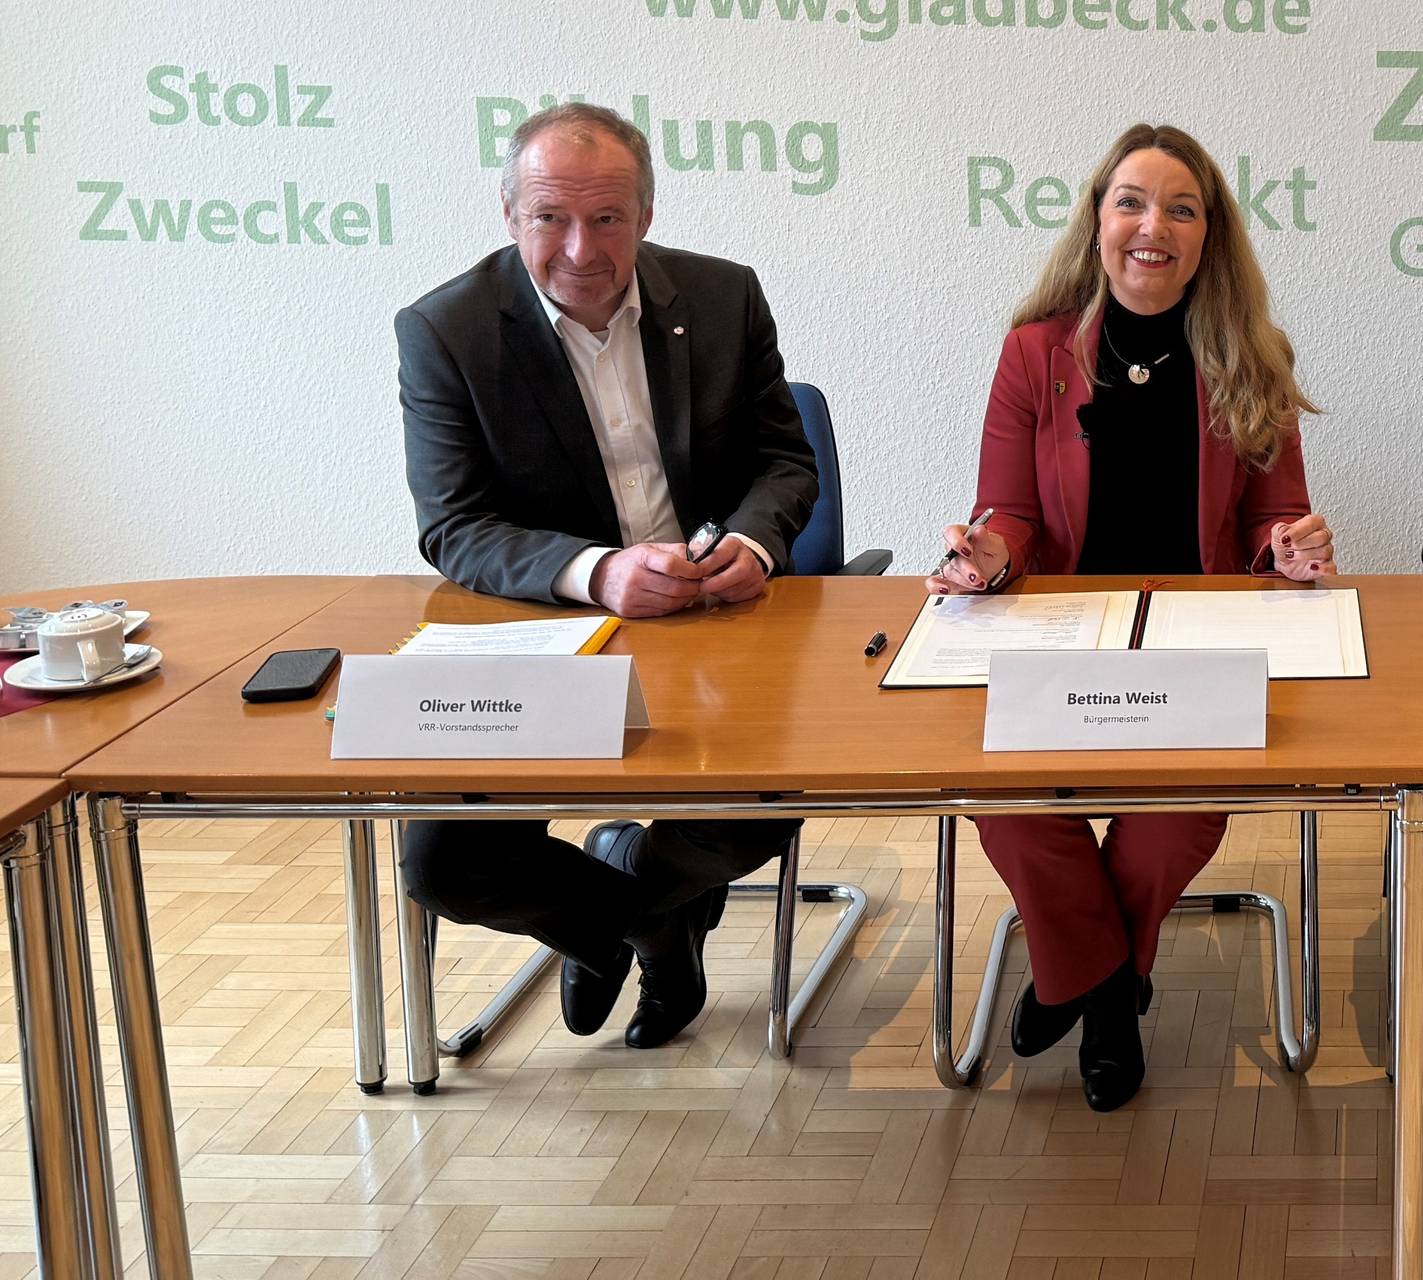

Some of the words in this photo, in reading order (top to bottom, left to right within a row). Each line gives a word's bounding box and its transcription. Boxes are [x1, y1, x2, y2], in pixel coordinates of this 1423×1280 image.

[147, 65, 336, 129] Stolz
[476, 94, 840, 196] Bung
[967, 155, 1317, 233] Rekt
[77, 181, 394, 247] Zweckel
[419, 699, 466, 713] Oliver
[470, 699, 523, 713] Wittke
[1067, 692, 1121, 705] Bettina
[1125, 691, 1168, 704] Weist
[418, 722, 519, 733] VRR-Vorstandssprecher
[1083, 715, 1149, 725] Bürgermeisterin
